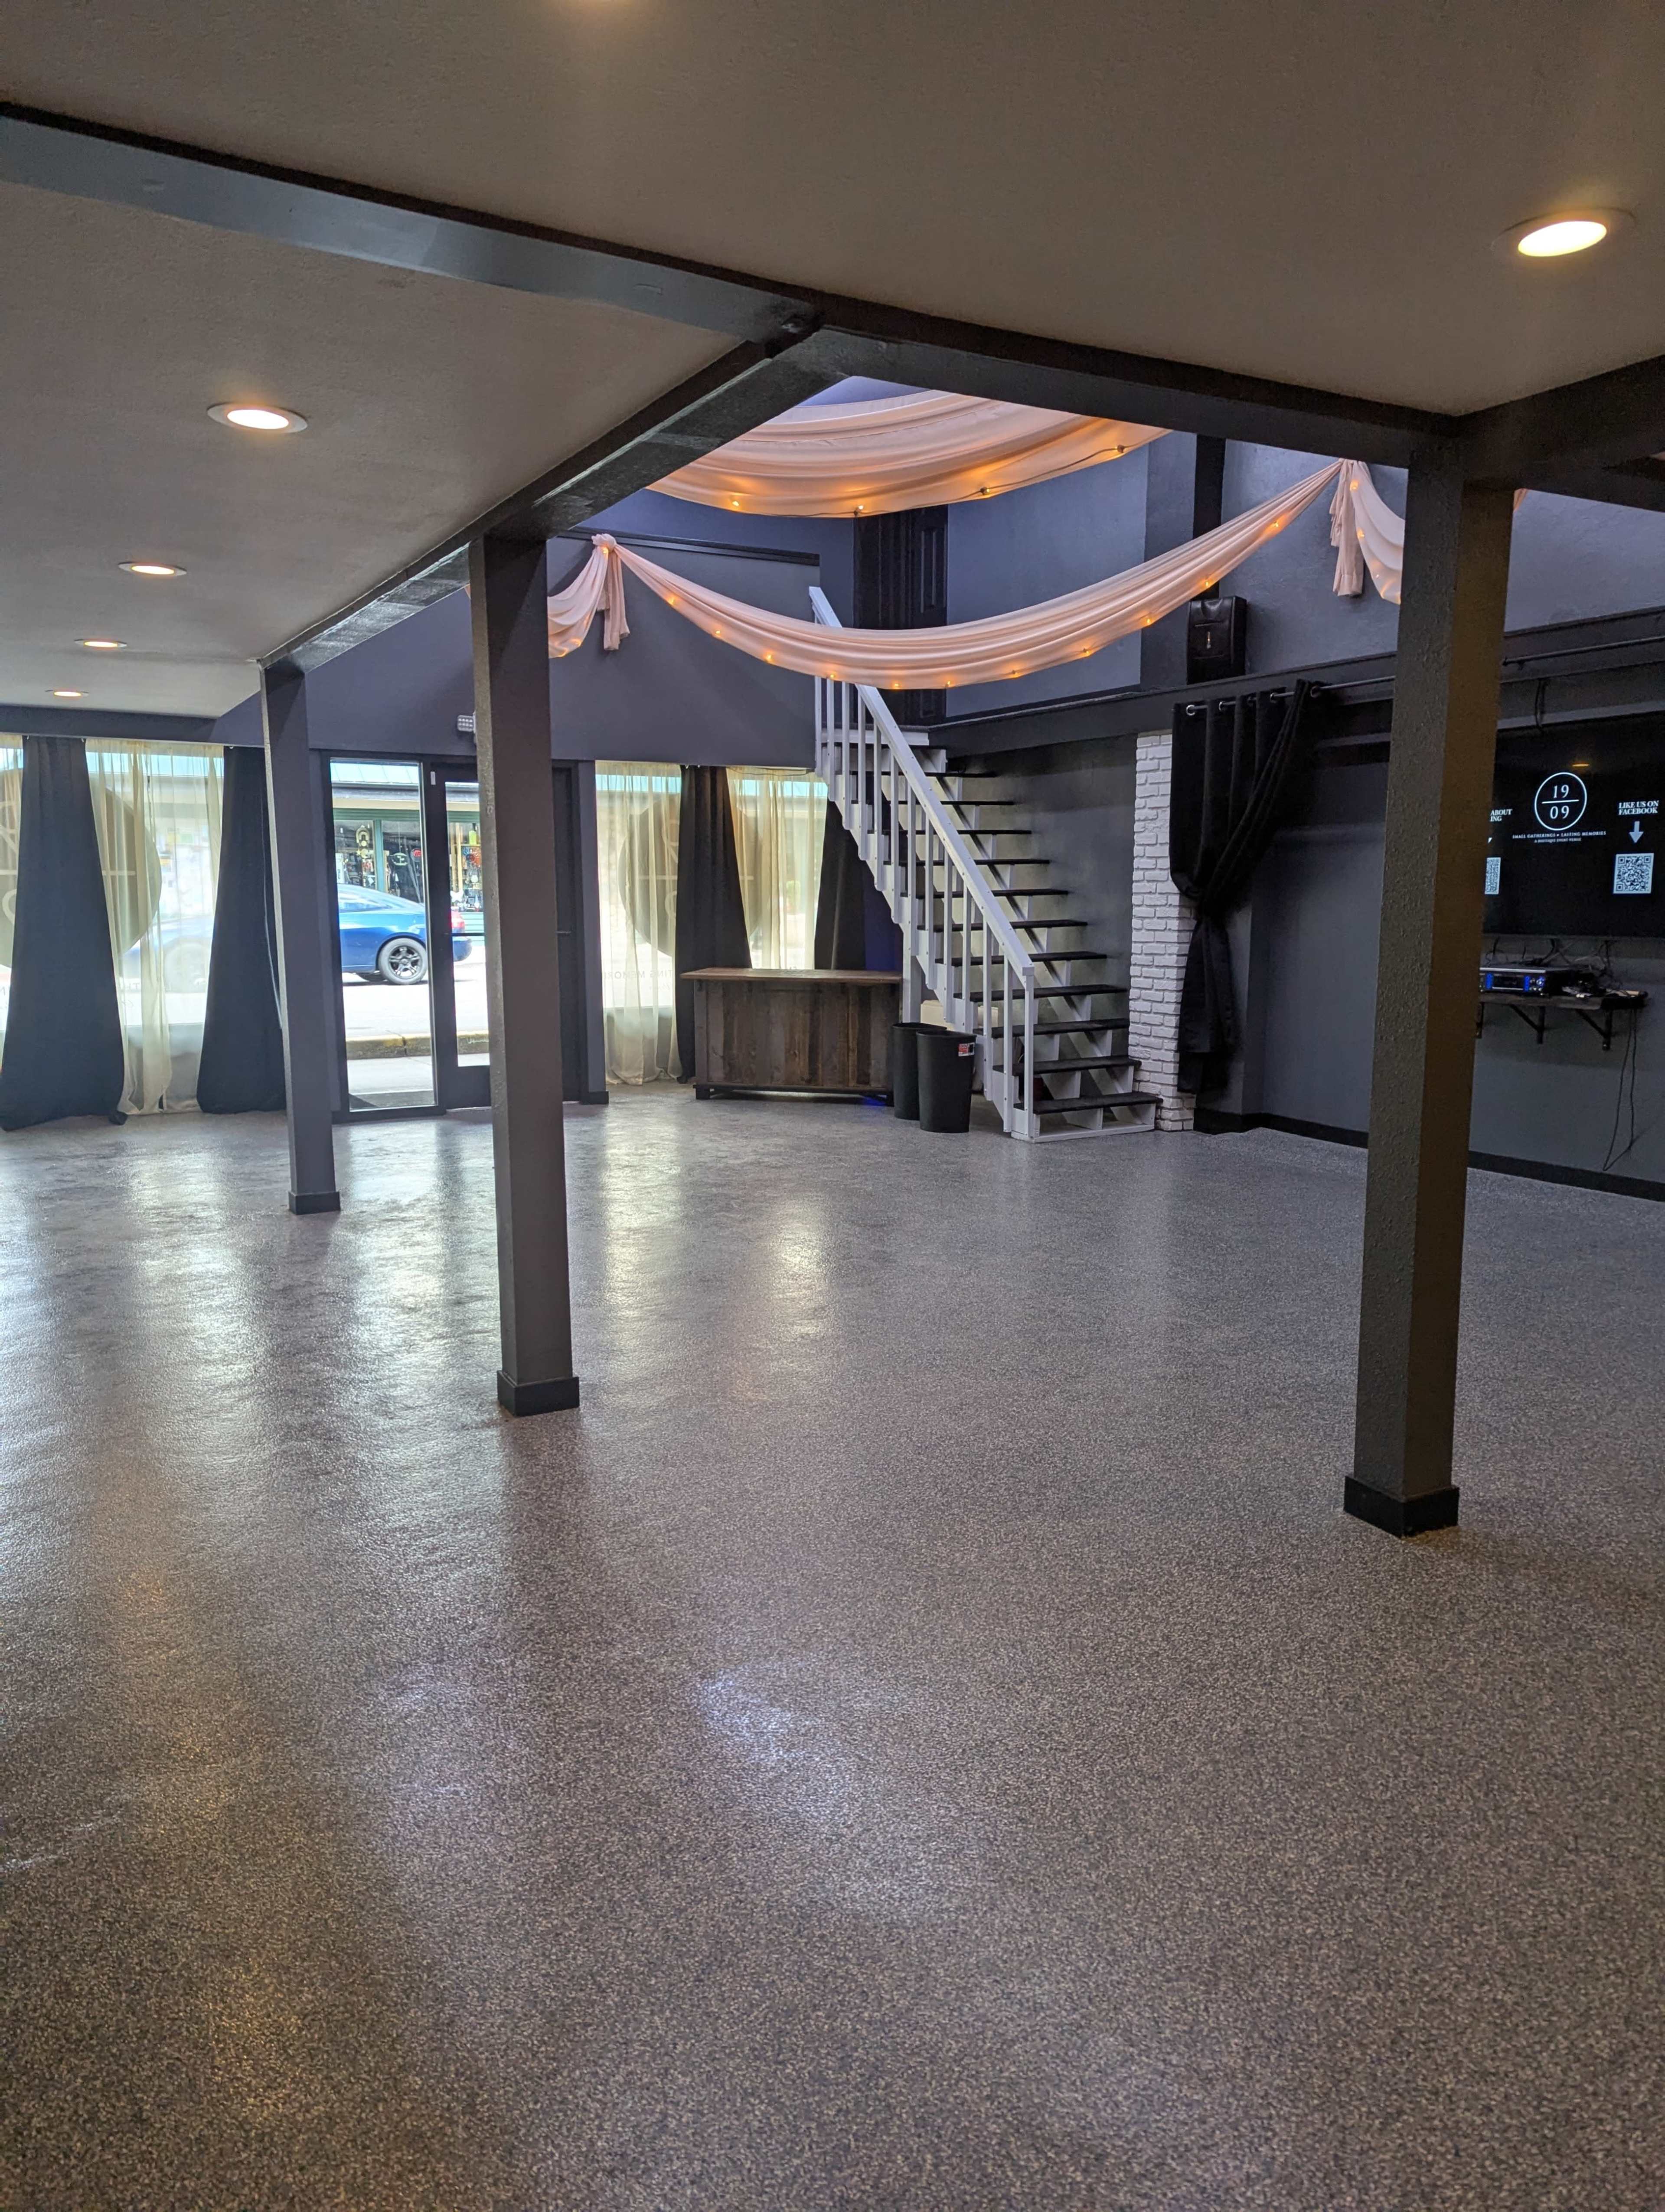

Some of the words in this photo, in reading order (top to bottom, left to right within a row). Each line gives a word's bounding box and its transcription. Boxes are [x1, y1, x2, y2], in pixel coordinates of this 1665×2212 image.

[1553, 784, 1569, 798] 19
[1550, 805, 1569, 819] 09
[1618, 807, 1658, 815] FACEBOOK
